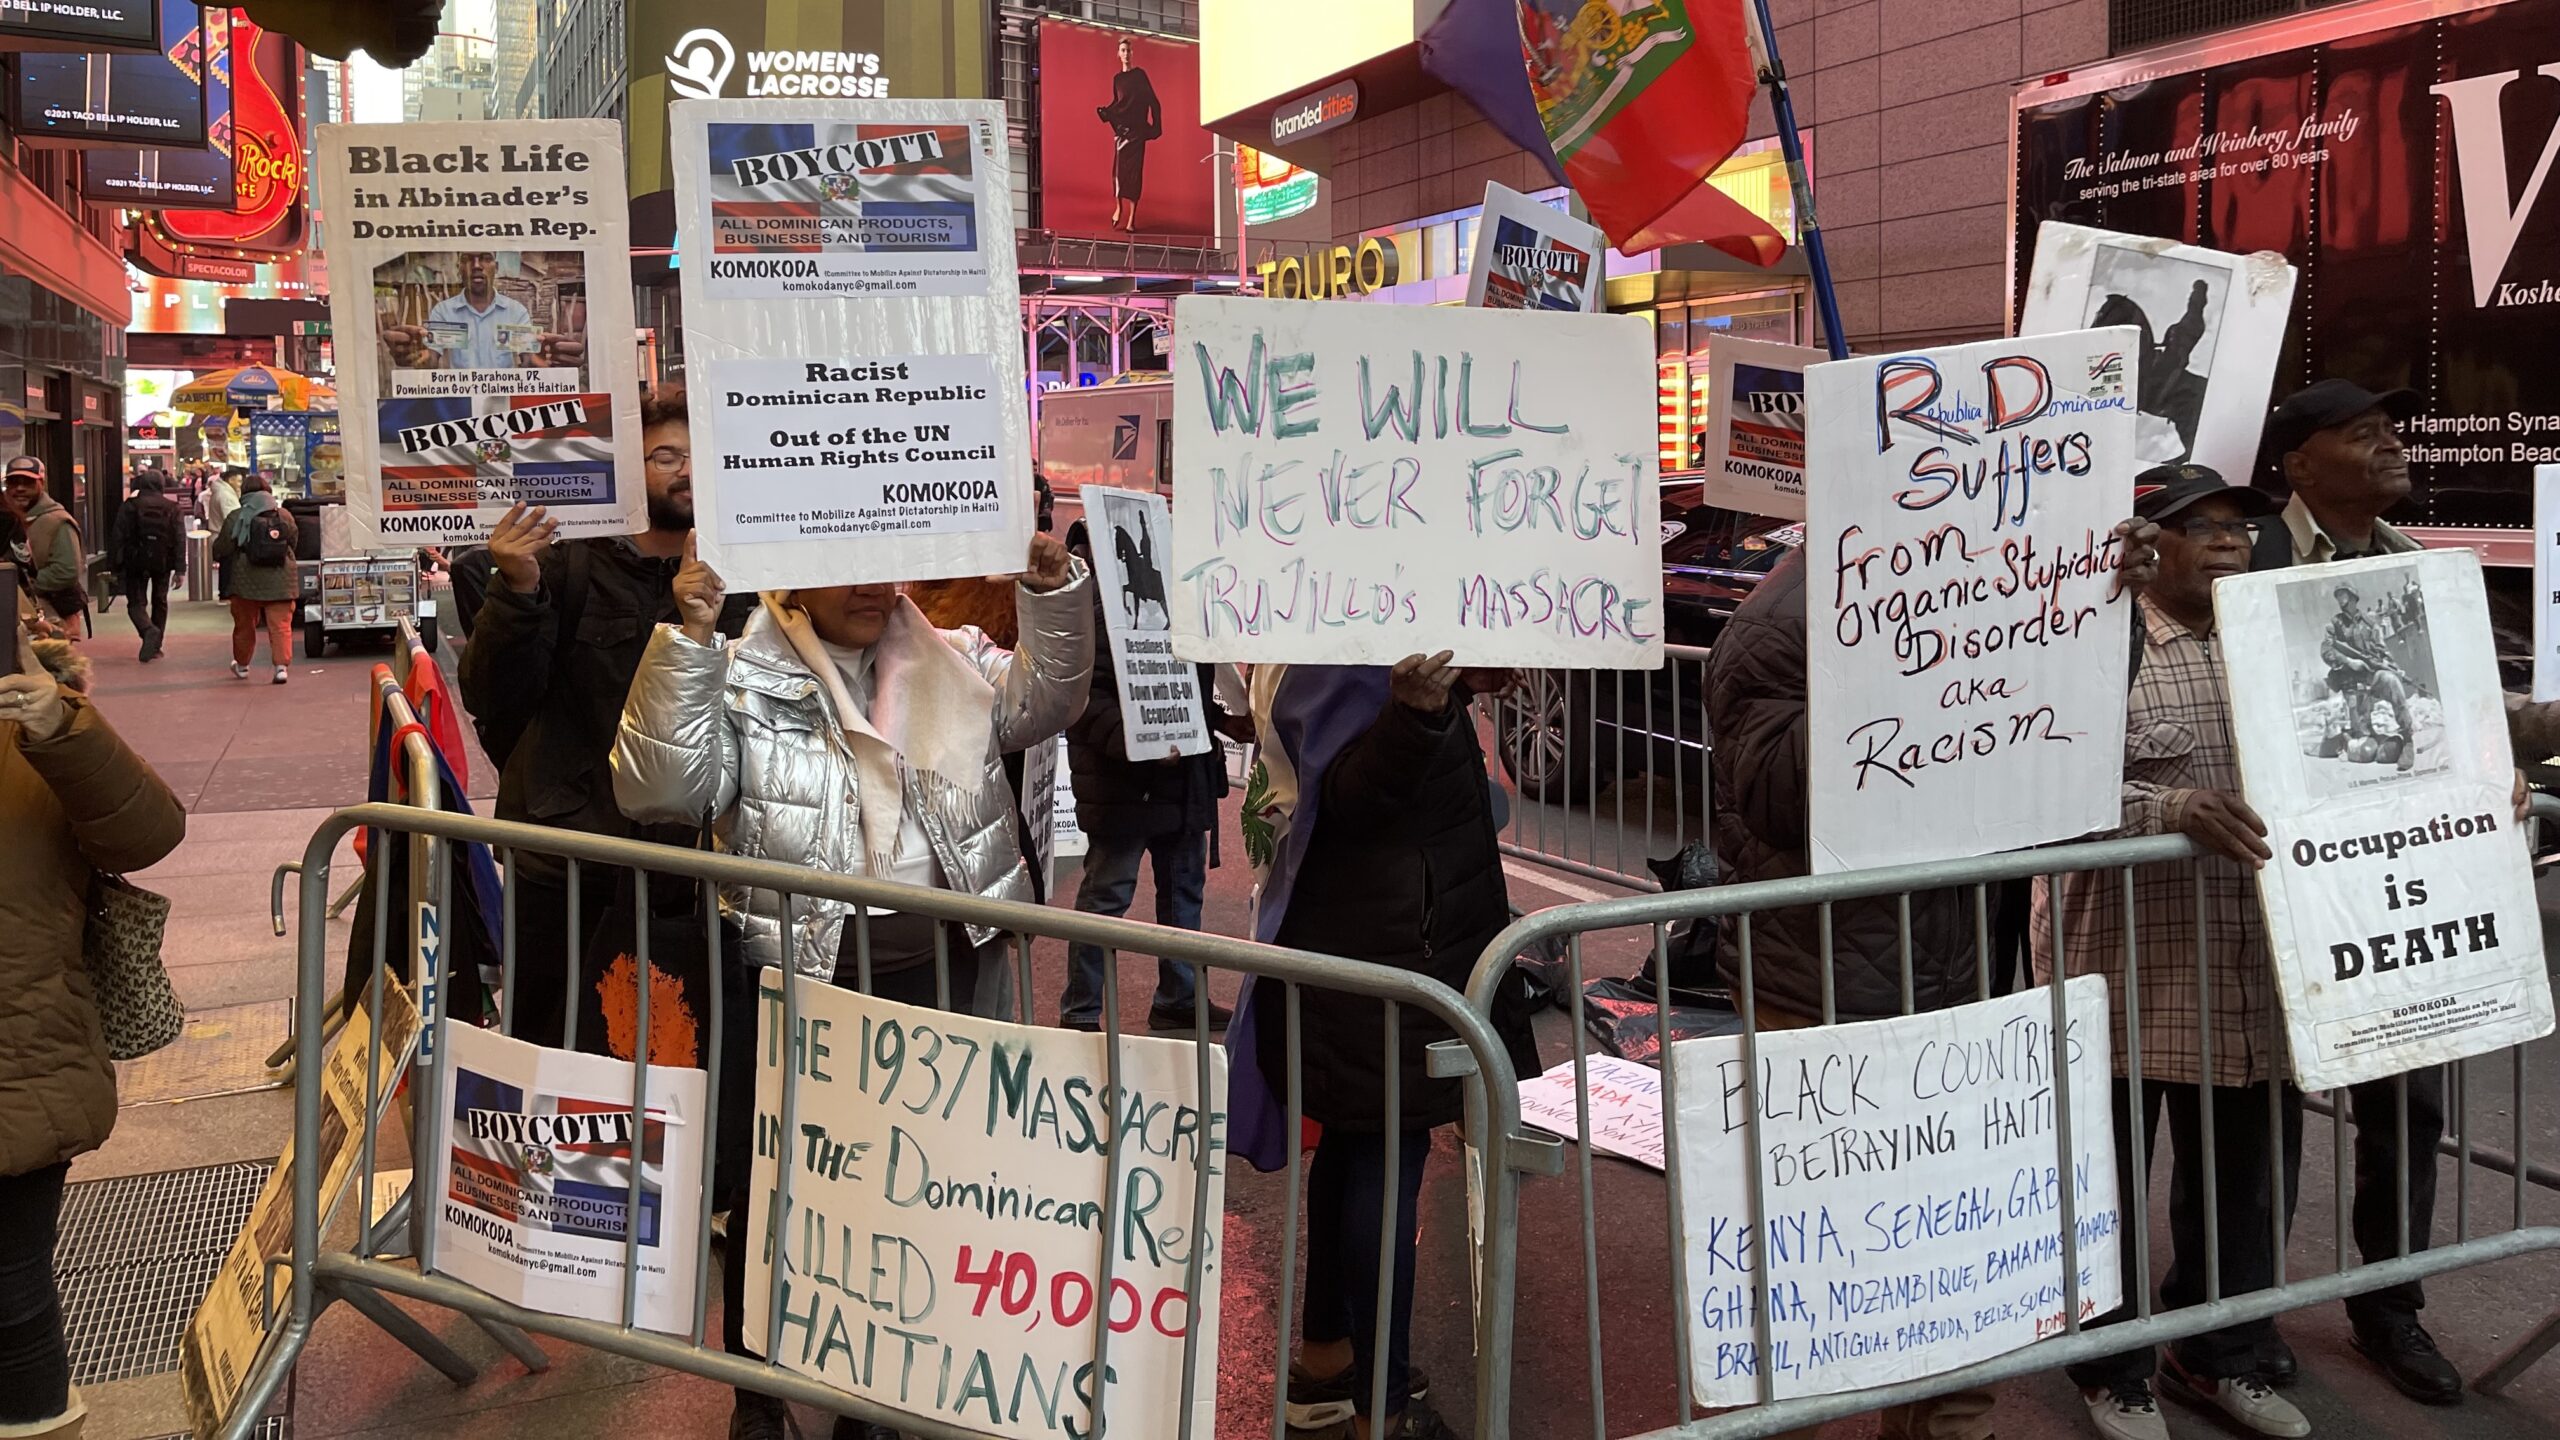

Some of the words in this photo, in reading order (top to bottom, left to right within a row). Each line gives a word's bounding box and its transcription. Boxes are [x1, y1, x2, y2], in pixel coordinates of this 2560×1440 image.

[13, 0, 39, 11] BELL
[41, 3, 51, 12] IP
[54, 4, 100, 18] HOLDER,
[102, 9, 124, 20] LLC.
[747, 51, 880, 75] WOMEN'S
[747, 75, 889, 98] LACROSSE
[73, 111, 95, 121] TACO
[97, 113, 116, 123] BELL
[117, 115, 125, 123] IP
[127, 115, 162, 127] HOLDER,
[163, 119, 180, 128] LLC.
[1275, 94, 1354, 139] brandedcities
[348, 146, 489, 174] Black
[500, 144, 589, 172] Life
[733, 132, 937, 187] BOYCOTT
[2064, 157, 2092, 181] The
[2098, 151, 2160, 176] Salmon
[2164, 134, 2201, 164] and
[2200, 126, 2288, 157] Weinberg
[2285, 108, 2360, 150] family
[241, 143, 297, 190] Rock
[2079, 181, 2119, 200] serving
[2122, 179, 2139, 193] the
[2142, 173, 2186, 190] tri-state
[2189, 167, 2217, 181] area
[2220, 163, 2238, 177] for
[2240, 158, 2269, 173] over
[2272, 153, 2289, 168] 80
[2291, 148, 2329, 166] years
[354, 188, 389, 208] in
[398, 186, 589, 208] Abinader's
[353, 219, 524, 239] Dominican
[530, 218, 597, 240] Rep.
[720, 219, 751, 230] ALL
[756, 218, 853, 230] DOMINICAN
[858, 218, 953, 231] PRODUCTS,
[725, 233, 832, 244] BUSINESSES
[836, 233, 872, 244] AND
[878, 232, 951, 243] TOURISM
[188, 263, 247, 278] SPECTACOLOR
[710, 260, 820, 279] KOMOKODA
[1256, 237, 1399, 300] TOURO
[1502, 245, 1579, 273] BOYCOTT
[782, 280, 917, 294] komokodanyc@gmail.com
[396, 384, 449, 395] Dominican
[481, 382, 514, 394] Claims
[517, 382, 536, 393] He's
[538, 381, 576, 393] Haitian
[431, 371, 456, 382] Born
[471, 371, 523, 383] Barahona,
[526, 370, 540, 381] DR
[805, 361, 909, 383] Racist
[1193, 330, 1321, 440] WE
[1357, 350, 1569, 444] WILL
[726, 390, 869, 407] Dominican
[875, 385, 986, 407] Republic
[400, 400, 583, 454] BOYCOTT
[770, 429, 820, 448] Out
[828, 428, 856, 445] of
[862, 427, 907, 444] the
[913, 425, 950, 442] UN
[2411, 413, 2500, 437] Hampton
[2507, 411, 2560, 436] Syna
[723, 454, 815, 470] Human
[820, 449, 899, 469] Rights
[905, 445, 996, 463] Council
[1725, 460, 1803, 486] KOMOKODA
[388, 480, 416, 491] ALL
[420, 478, 506, 491] DOMINICAN
[509, 475, 595, 488] PRODUCTS,
[392, 490, 488, 504] BUSINESSES
[491, 489, 523, 501] AND
[526, 488, 592, 500] TOURISM
[883, 480, 998, 504] KOMOKODA
[1210, 449, 1426, 547] NEVER
[1466, 449, 1658, 546] FORGET
[380, 515, 475, 534] KOMOKODA
[735, 512, 797, 524] (Committee
[799, 511, 809, 521] to
[811, 508, 855, 521] Mobilize
[858, 506, 897, 519] Against
[898, 504, 958, 518] Dictatorship
[971, 501, 999, 514] Haiti)
[799, 519, 931, 535] komokodanyc@gmail.com
[1835, 524, 1992, 610] from
[1458, 568, 1656, 645] MASSACRE
[1837, 577, 1988, 662] Organic
[1993, 528, 2127, 608] Stupidity
[1900, 600, 2097, 676] Disorder
[1128, 682, 1152, 701] Down
[1152, 682, 1170, 700] with
[1940, 677, 2022, 708] aka
[1140, 704, 1190, 726] Occupation
[1846, 705, 2077, 791] Racism
[2292, 813, 2497, 867] Occupation
[2384, 874, 2428, 910] is
[2329, 912, 2499, 981] DEATH
[2393, 996, 2457, 1018] KOMOKODA
[760, 986, 832, 1082] THE
[859, 1014, 980, 1121] 1937
[1913, 1015, 2083, 1100] COUNTRIS
[468, 1109, 633, 1145] BOYCOTT
[1769, 1110, 1956, 1187] BETRAYING
[1983, 1087, 2054, 1150] HAITI
[454, 1165, 475, 1183] ALL
[477, 1174, 544, 1206] DOMINICAN
[801, 1122, 875, 1182] THE
[885, 1126, 1104, 1238] Dominican
[455, 1181, 525, 1217] BUSINESSES
[528, 1207, 560, 1223] AND
[1708, 1205, 1857, 1276] KENYA,
[1865, 1186, 2002, 1254] SENEGAL,
[2007, 1153, 2090, 1219] GABN
[445, 1204, 514, 1247] KOMOKODA
[488, 1243, 597, 1279] komokodanyc@gmail.com
[955, 1245, 1201, 1339] 40,000
[1828, 1263, 1978, 1322] MOZAMBIQUE,
[1714, 1342, 1802, 1380] BRAIL,
[1897, 1315, 1969, 1352] BARBUDA,
[1974, 1302, 2020, 1334] BELIZE,
[779, 1278, 1119, 1440] HAITIANS
